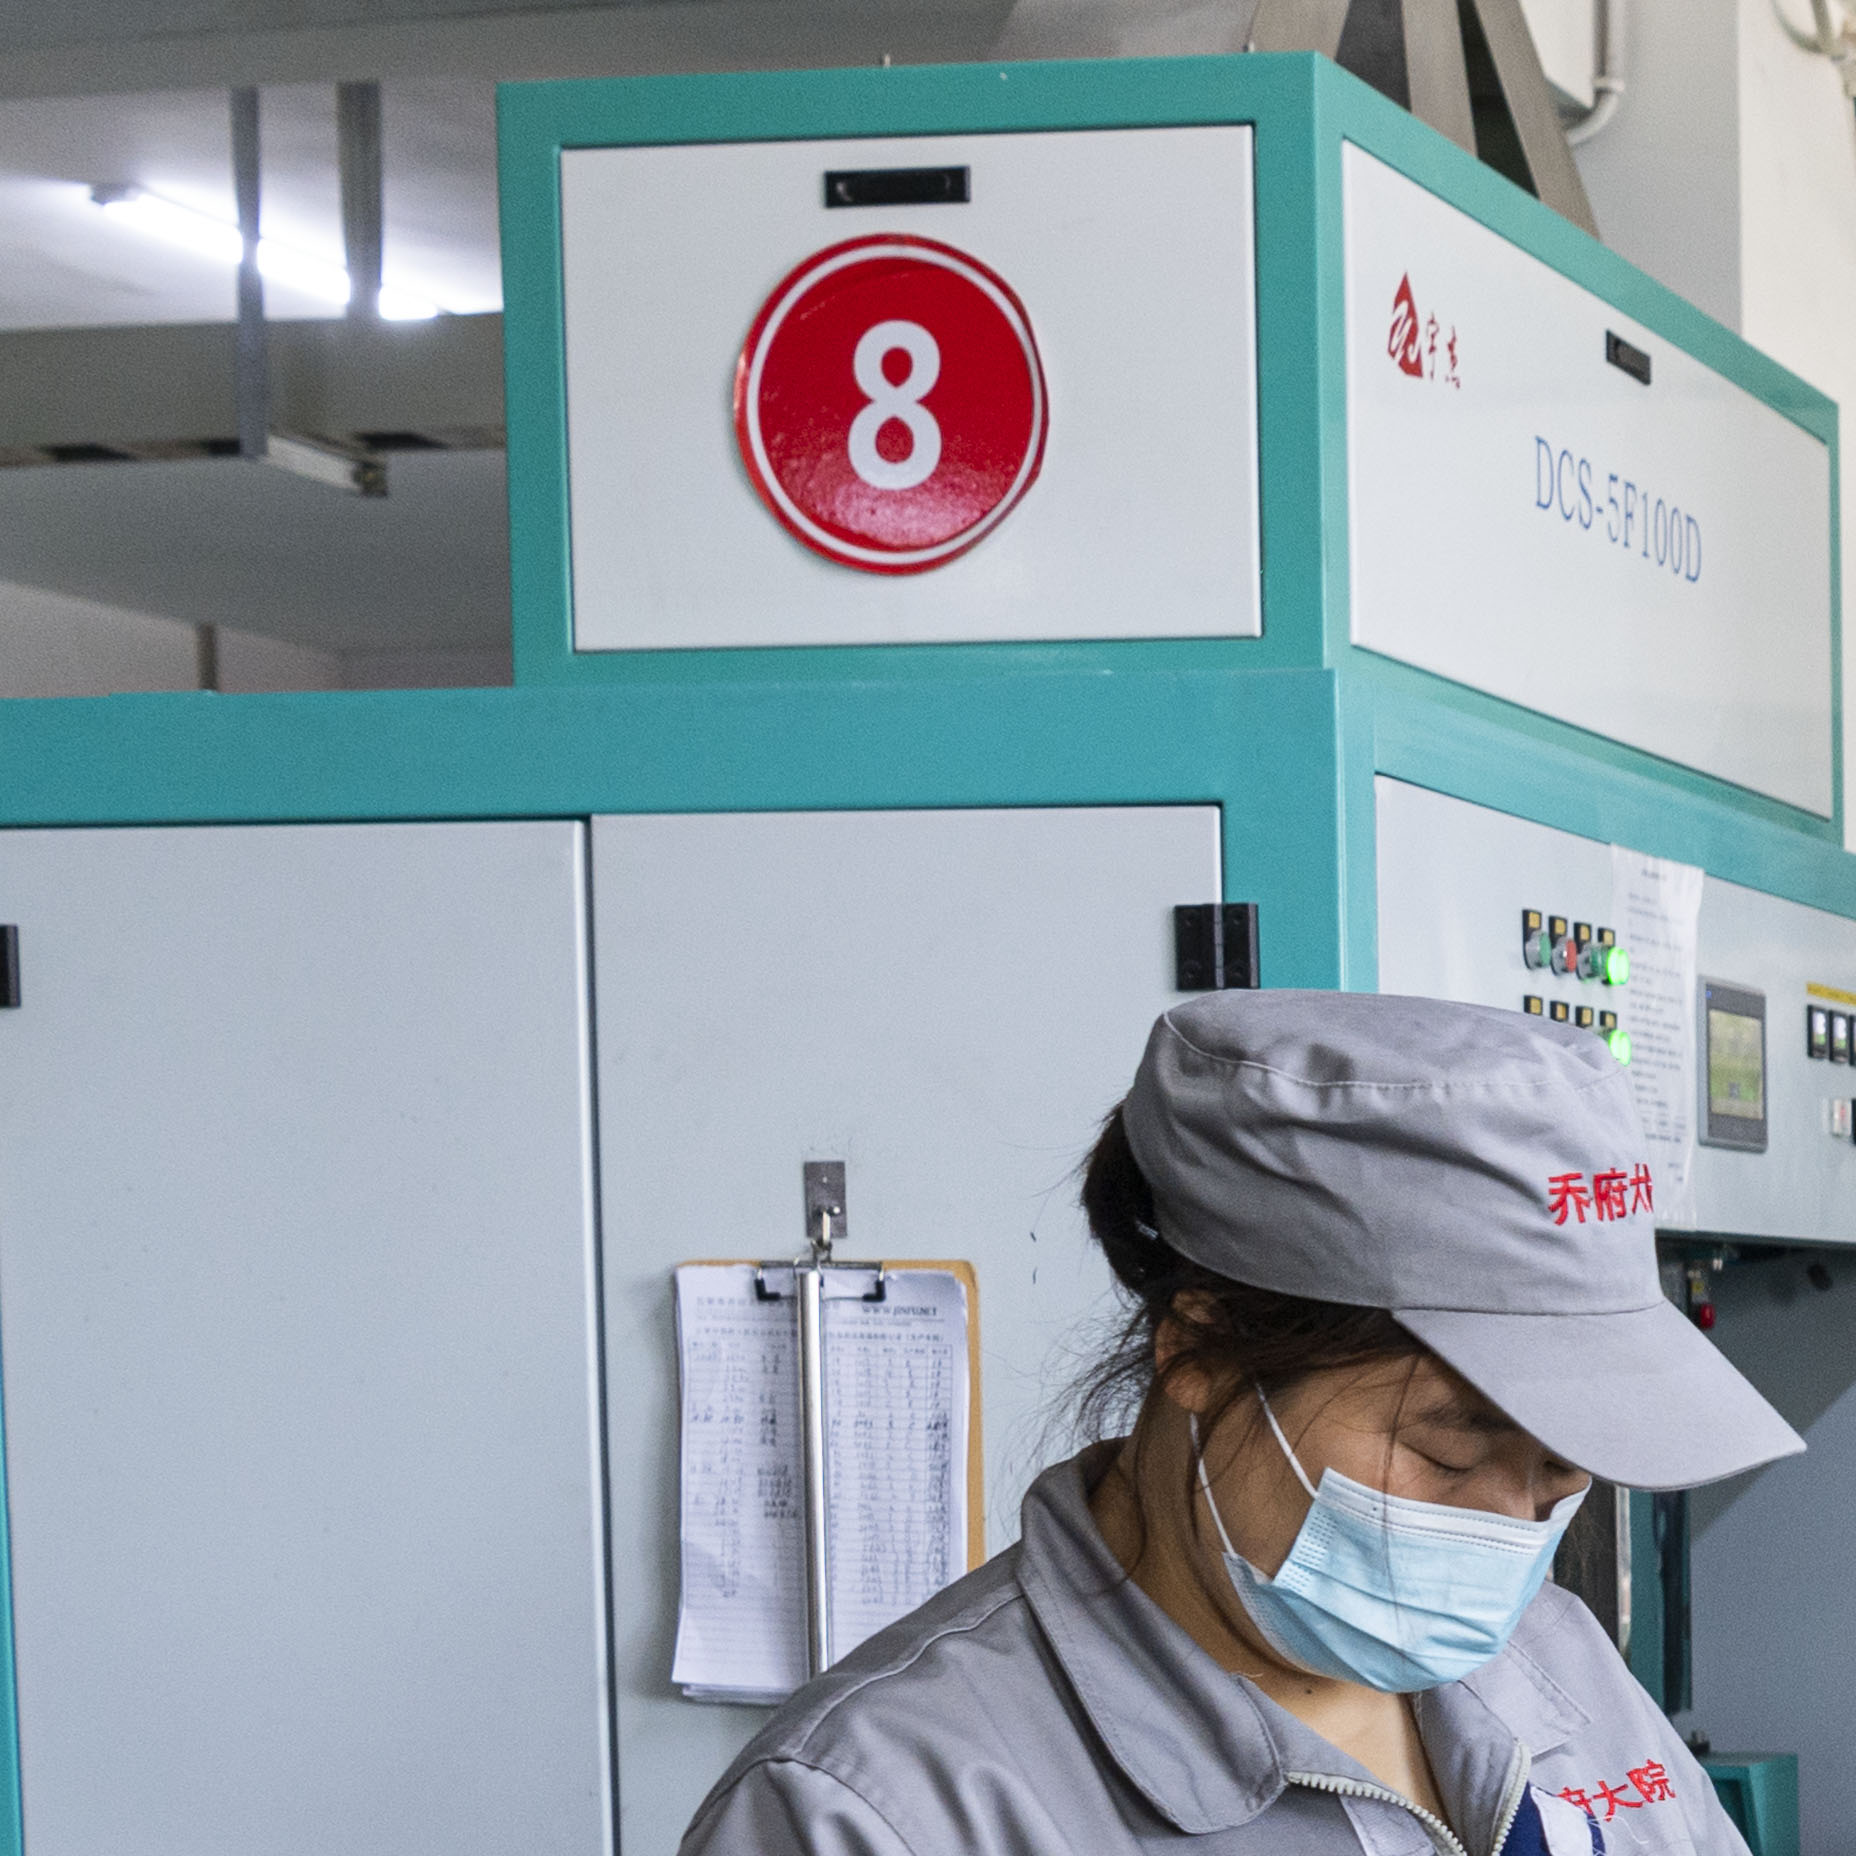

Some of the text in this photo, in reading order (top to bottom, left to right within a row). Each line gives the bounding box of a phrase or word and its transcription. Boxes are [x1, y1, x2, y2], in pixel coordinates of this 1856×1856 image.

[848, 320, 942, 493] 8
[1535, 435, 1701, 583] DCS-5F100D
[1547, 1162, 1654, 1226] 乔府大
